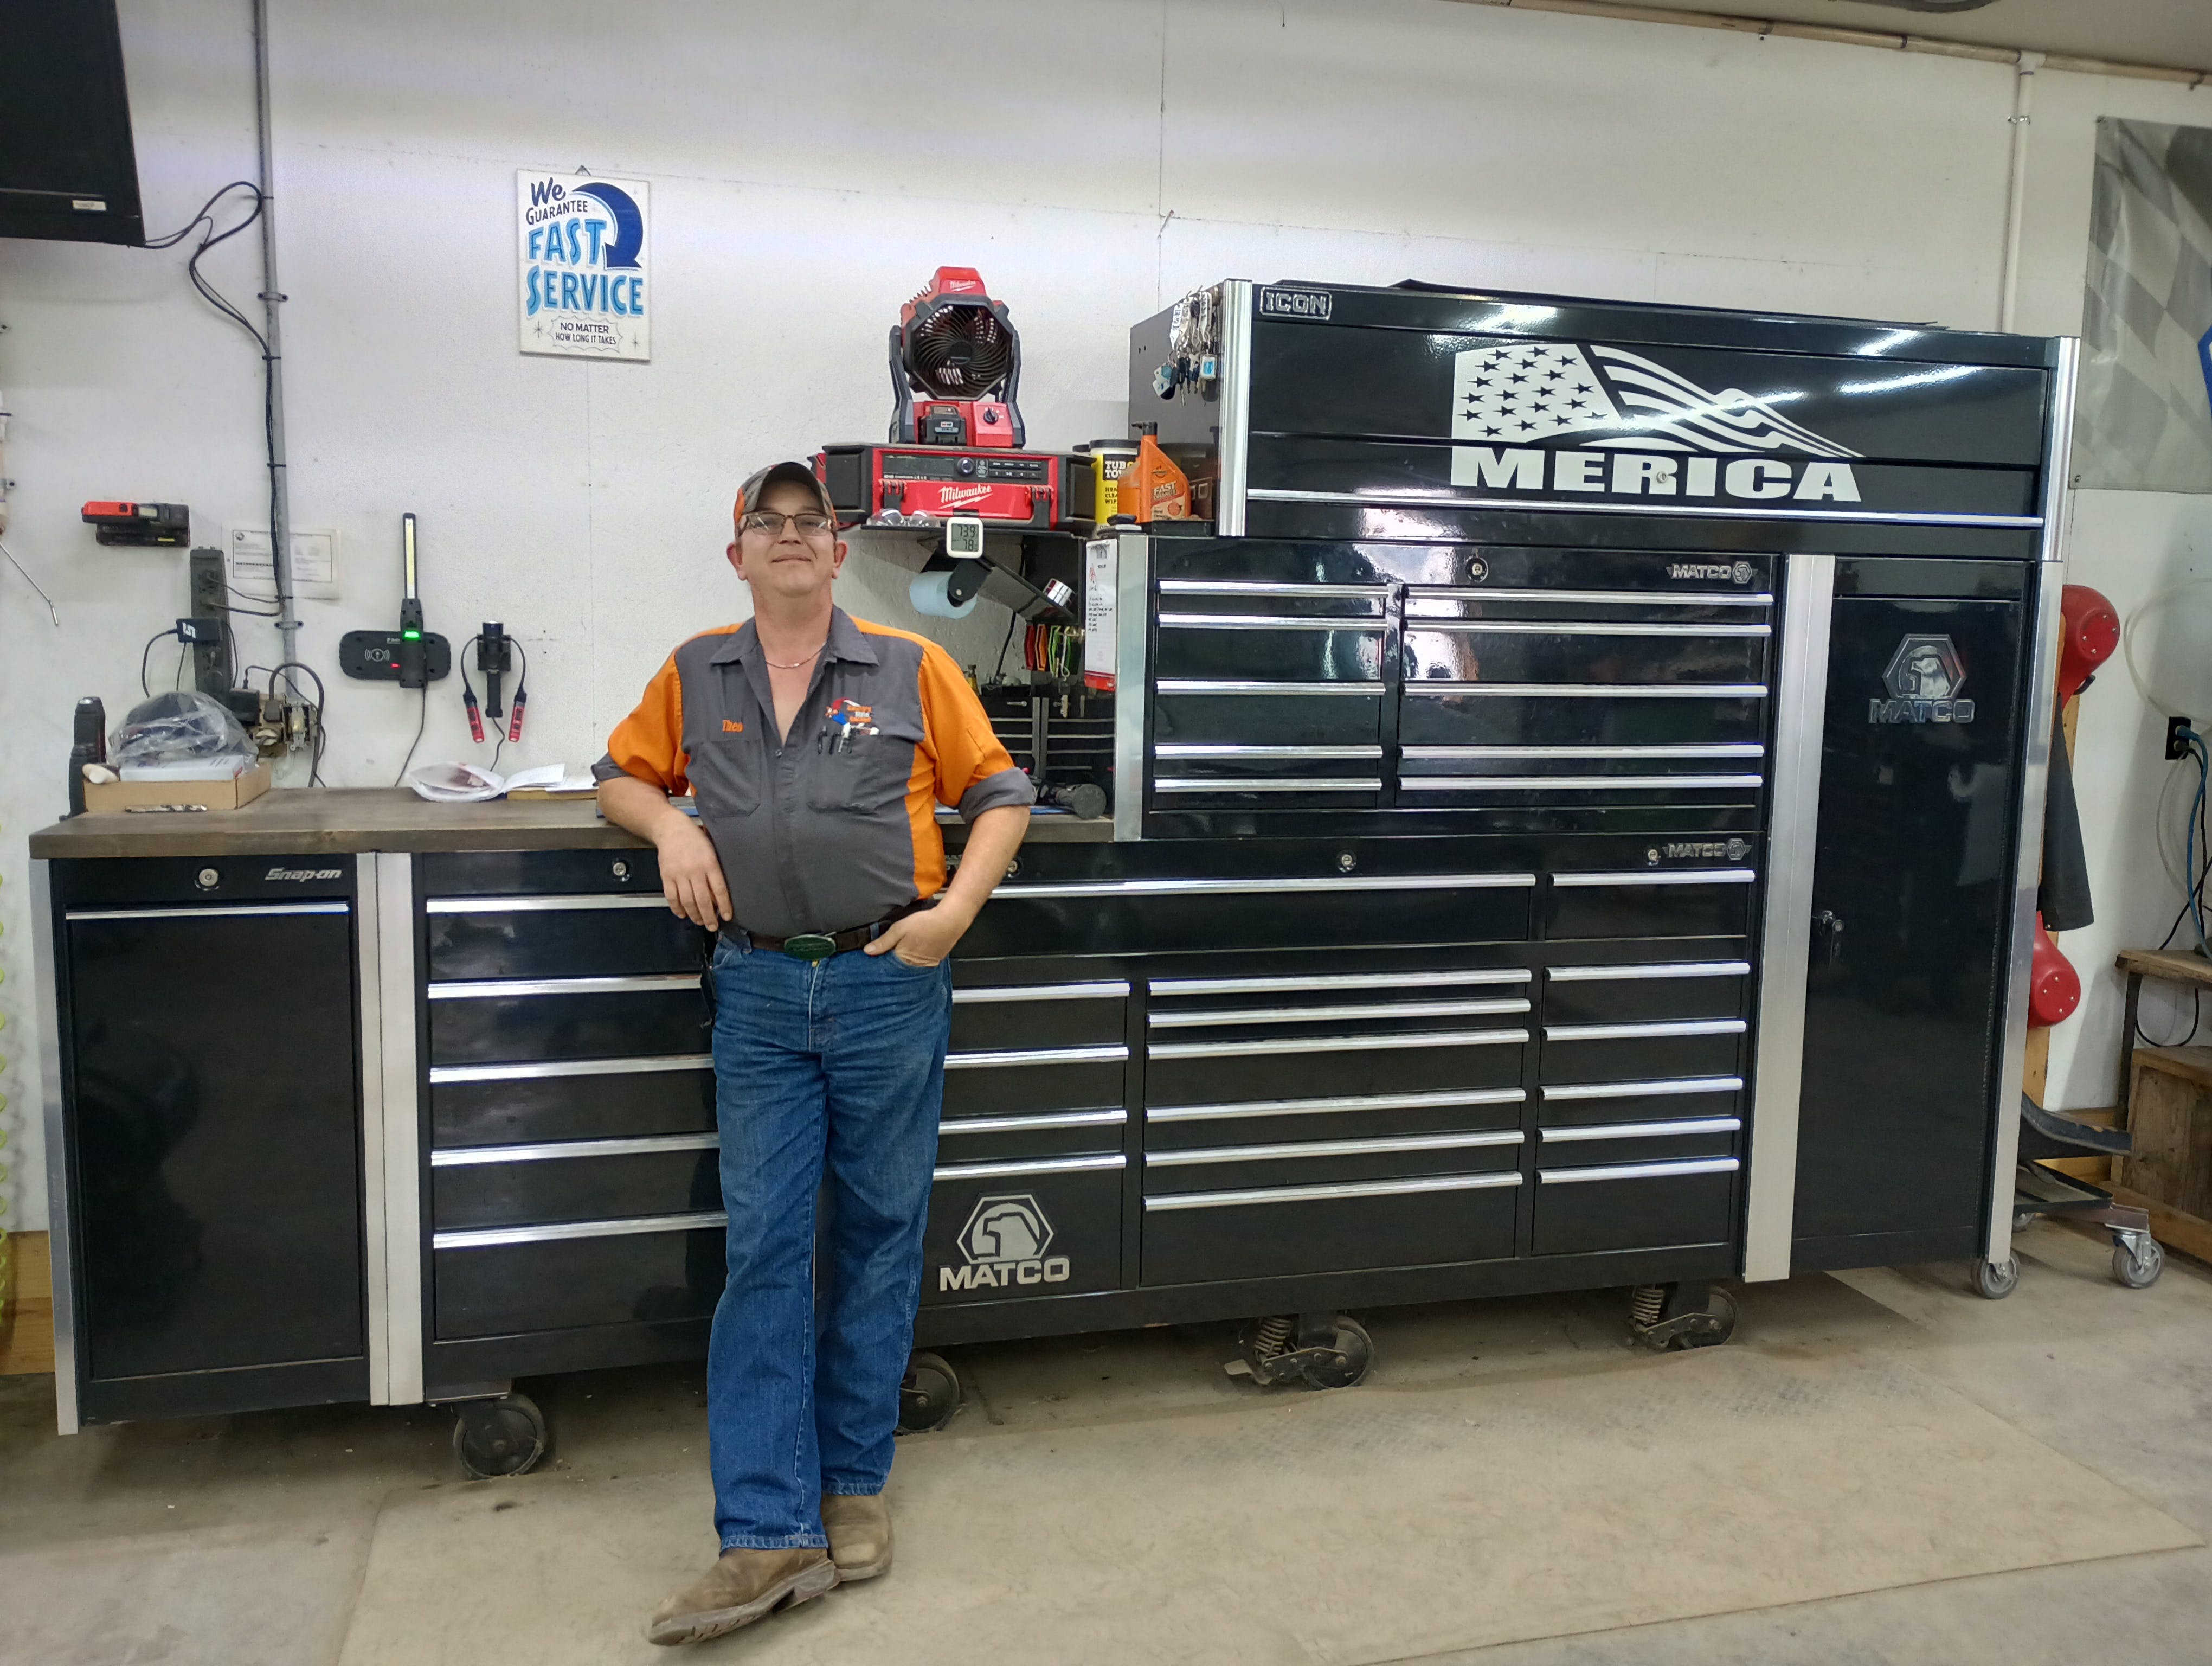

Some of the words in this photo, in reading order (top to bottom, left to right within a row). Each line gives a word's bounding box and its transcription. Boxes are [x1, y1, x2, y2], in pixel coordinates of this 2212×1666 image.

[531, 177, 566, 207] We
[526, 200, 588, 225] GUARANTEE
[528, 218, 607, 265] FAST
[526, 265, 644, 316] SERVICE
[1266, 292, 1326, 315] ICON
[555, 332, 571, 341] HOW
[573, 334, 589, 343] LONG
[591, 335, 596, 343] IT
[598, 335, 616, 344] TAKES
[560, 322, 574, 331] NO
[575, 323, 609, 334] MATTER
[1105, 460, 1126, 470] TUB
[1451, 446, 1862, 502] MERICA
[938, 484, 992, 503] Milwaukee
[1154, 480, 1176, 495] FAST
[1672, 564, 1732, 579] MATCO
[1868, 699, 1975, 723] MATCO
[1667, 843, 1726, 858] MATCO
[265, 868, 342, 882] Snap-on
[940, 1257, 1070, 1291] MATCO
